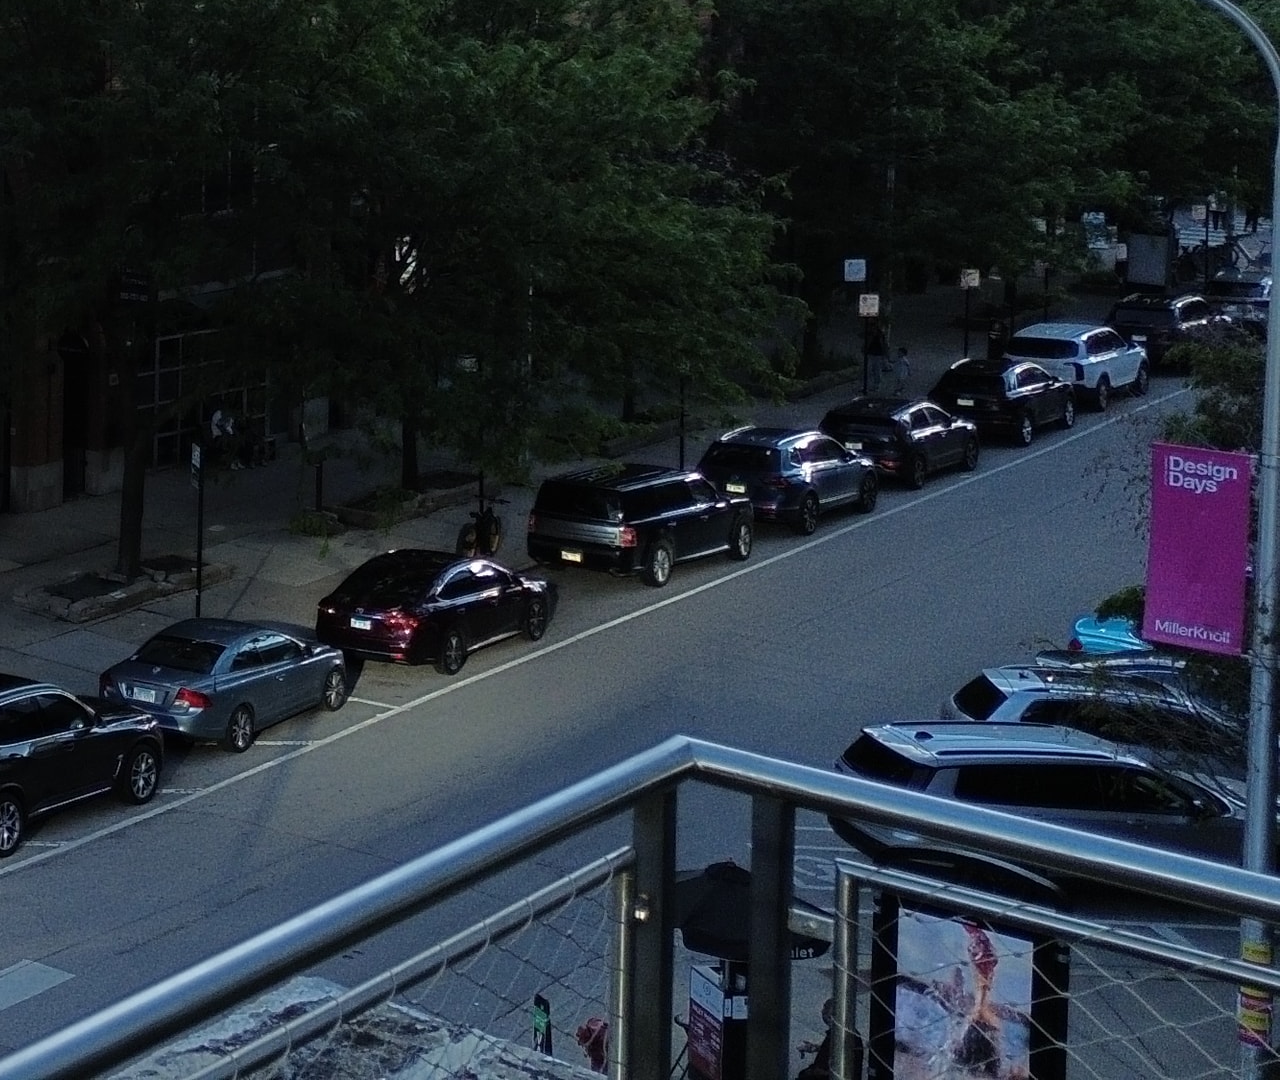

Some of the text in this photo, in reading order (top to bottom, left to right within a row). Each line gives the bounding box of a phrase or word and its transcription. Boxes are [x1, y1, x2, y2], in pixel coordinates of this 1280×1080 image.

[1168, 455, 1238, 481] Design
[1168, 471, 1218, 494] Days
[1155, 619, 1230, 644] MillerKnoll
